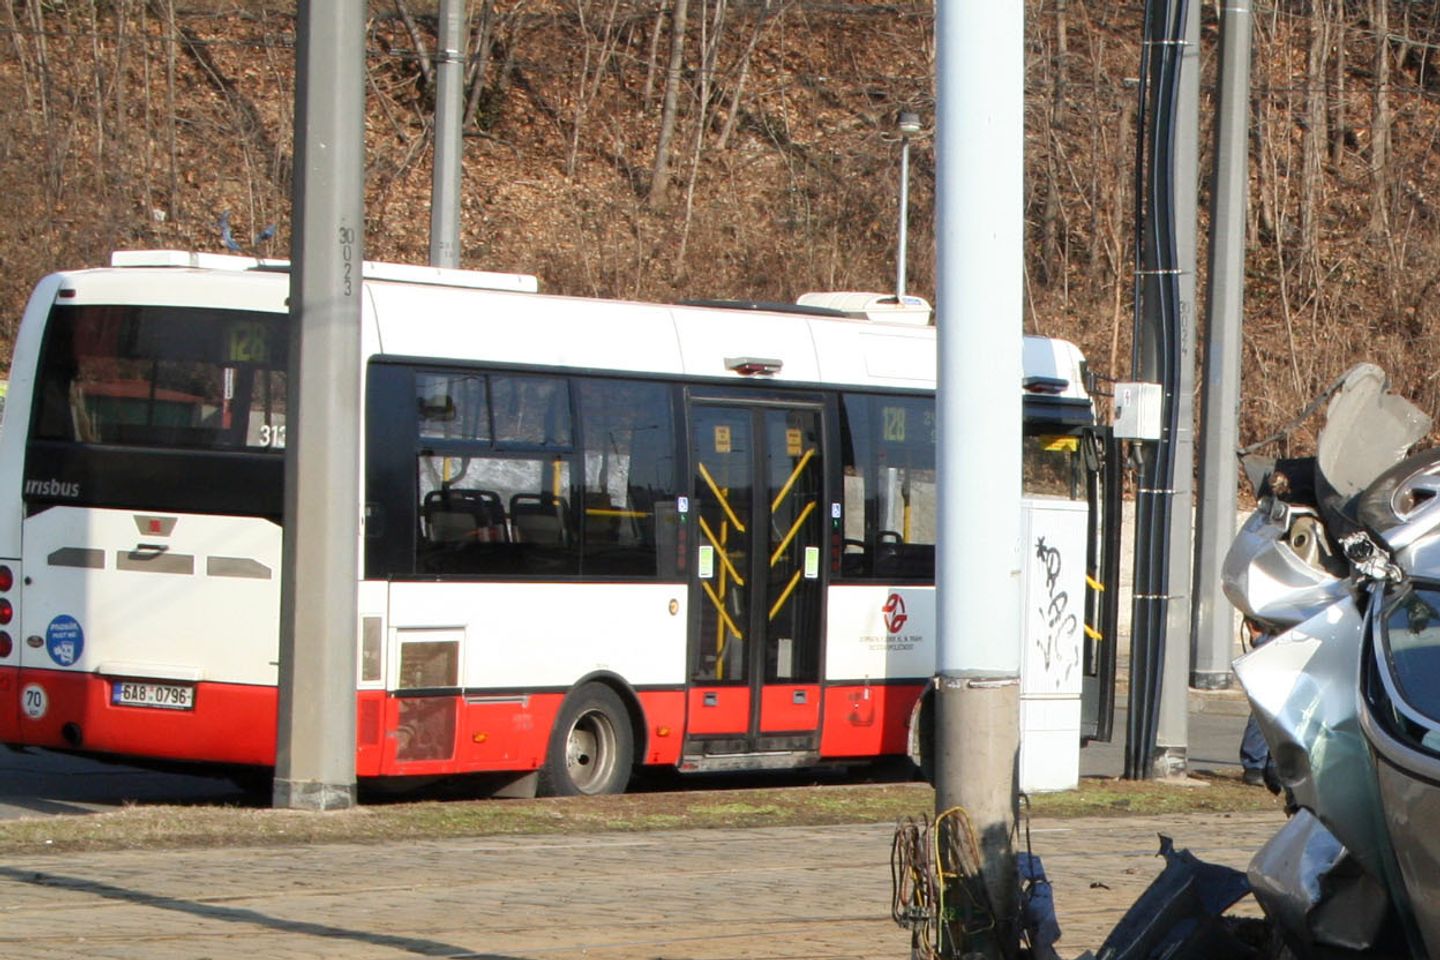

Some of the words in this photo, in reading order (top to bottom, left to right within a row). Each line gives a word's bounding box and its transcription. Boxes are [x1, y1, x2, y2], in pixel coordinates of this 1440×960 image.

[26, 691, 42, 707] 70
[123, 685, 146, 702] 6A8
[155, 686, 187, 704] 0796
